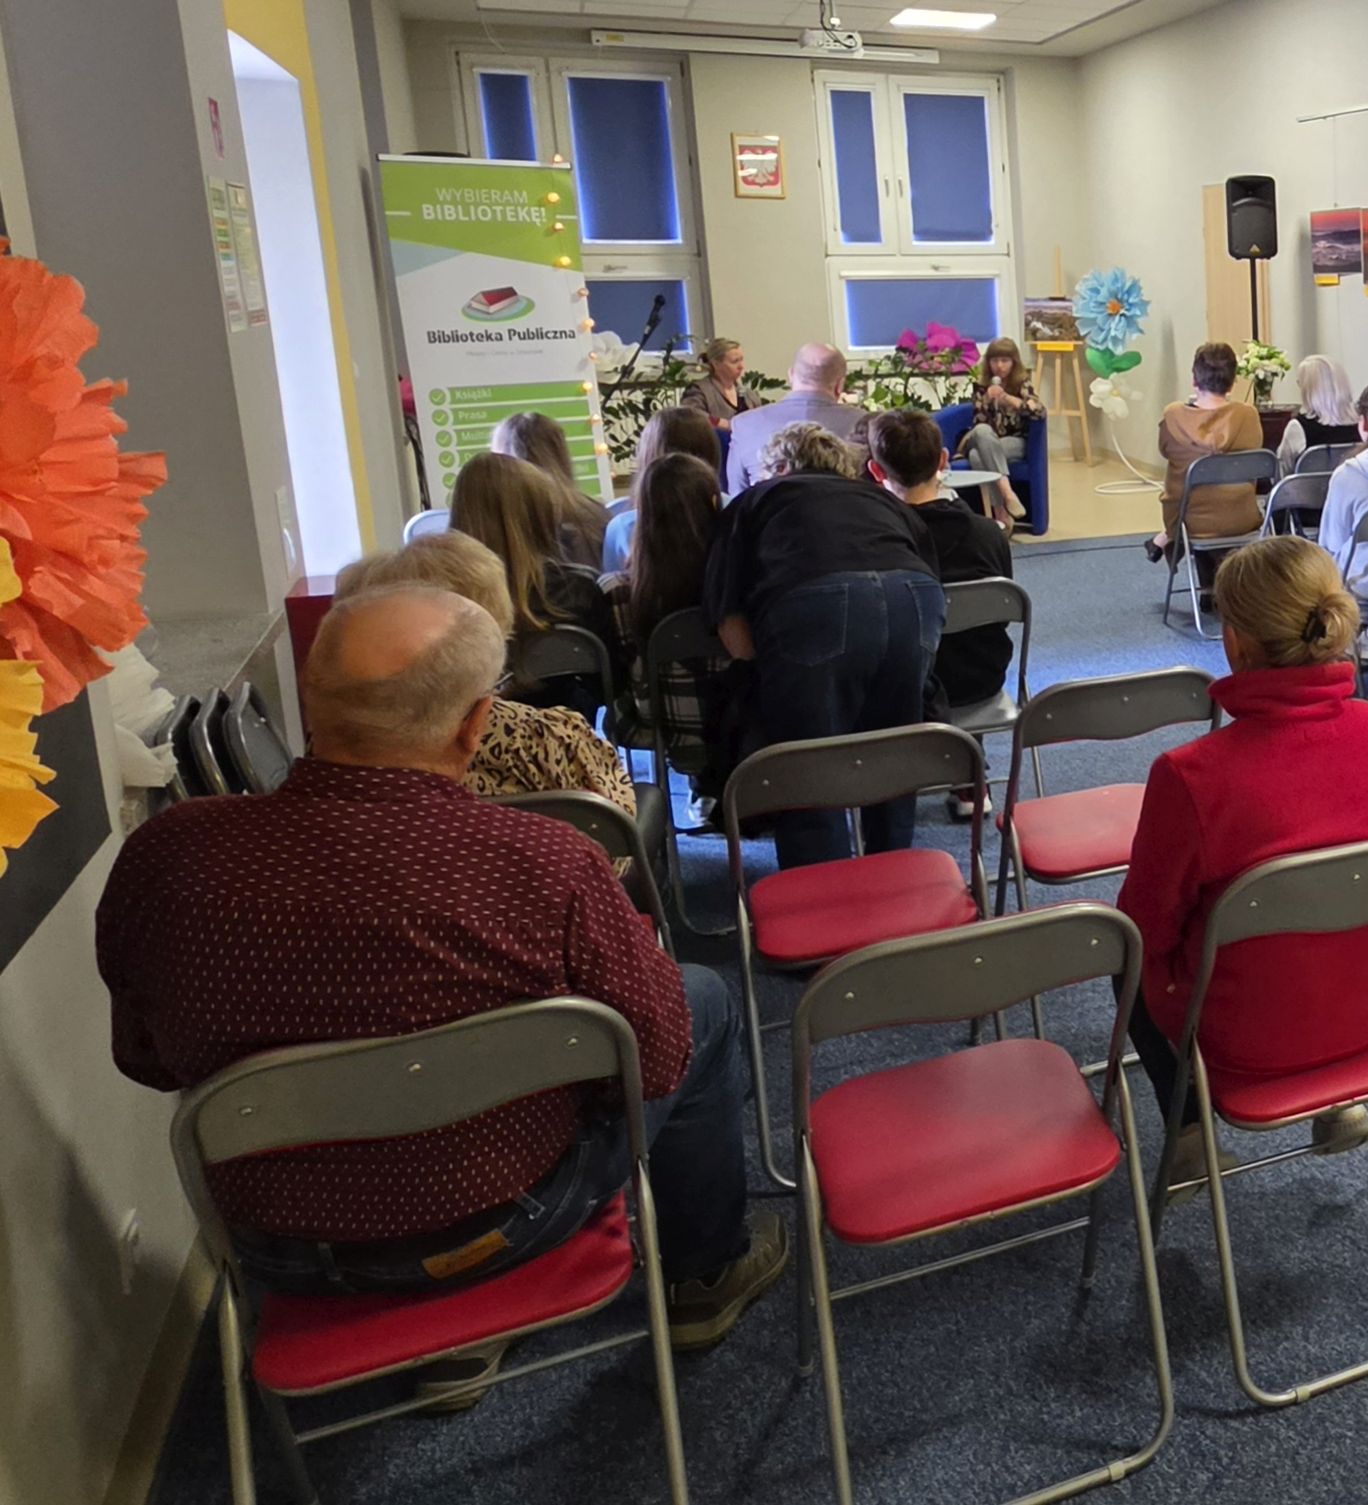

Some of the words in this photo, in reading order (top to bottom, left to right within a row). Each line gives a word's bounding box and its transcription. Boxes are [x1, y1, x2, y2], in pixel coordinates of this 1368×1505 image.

[435, 187, 529, 204] WYBIERAM
[421, 203, 546, 226] BIBLIOTEKĘ!
[426, 328, 504, 344] Biblioteka
[508, 326, 576, 342] Publiczna
[458, 410, 488, 420] Prasa
